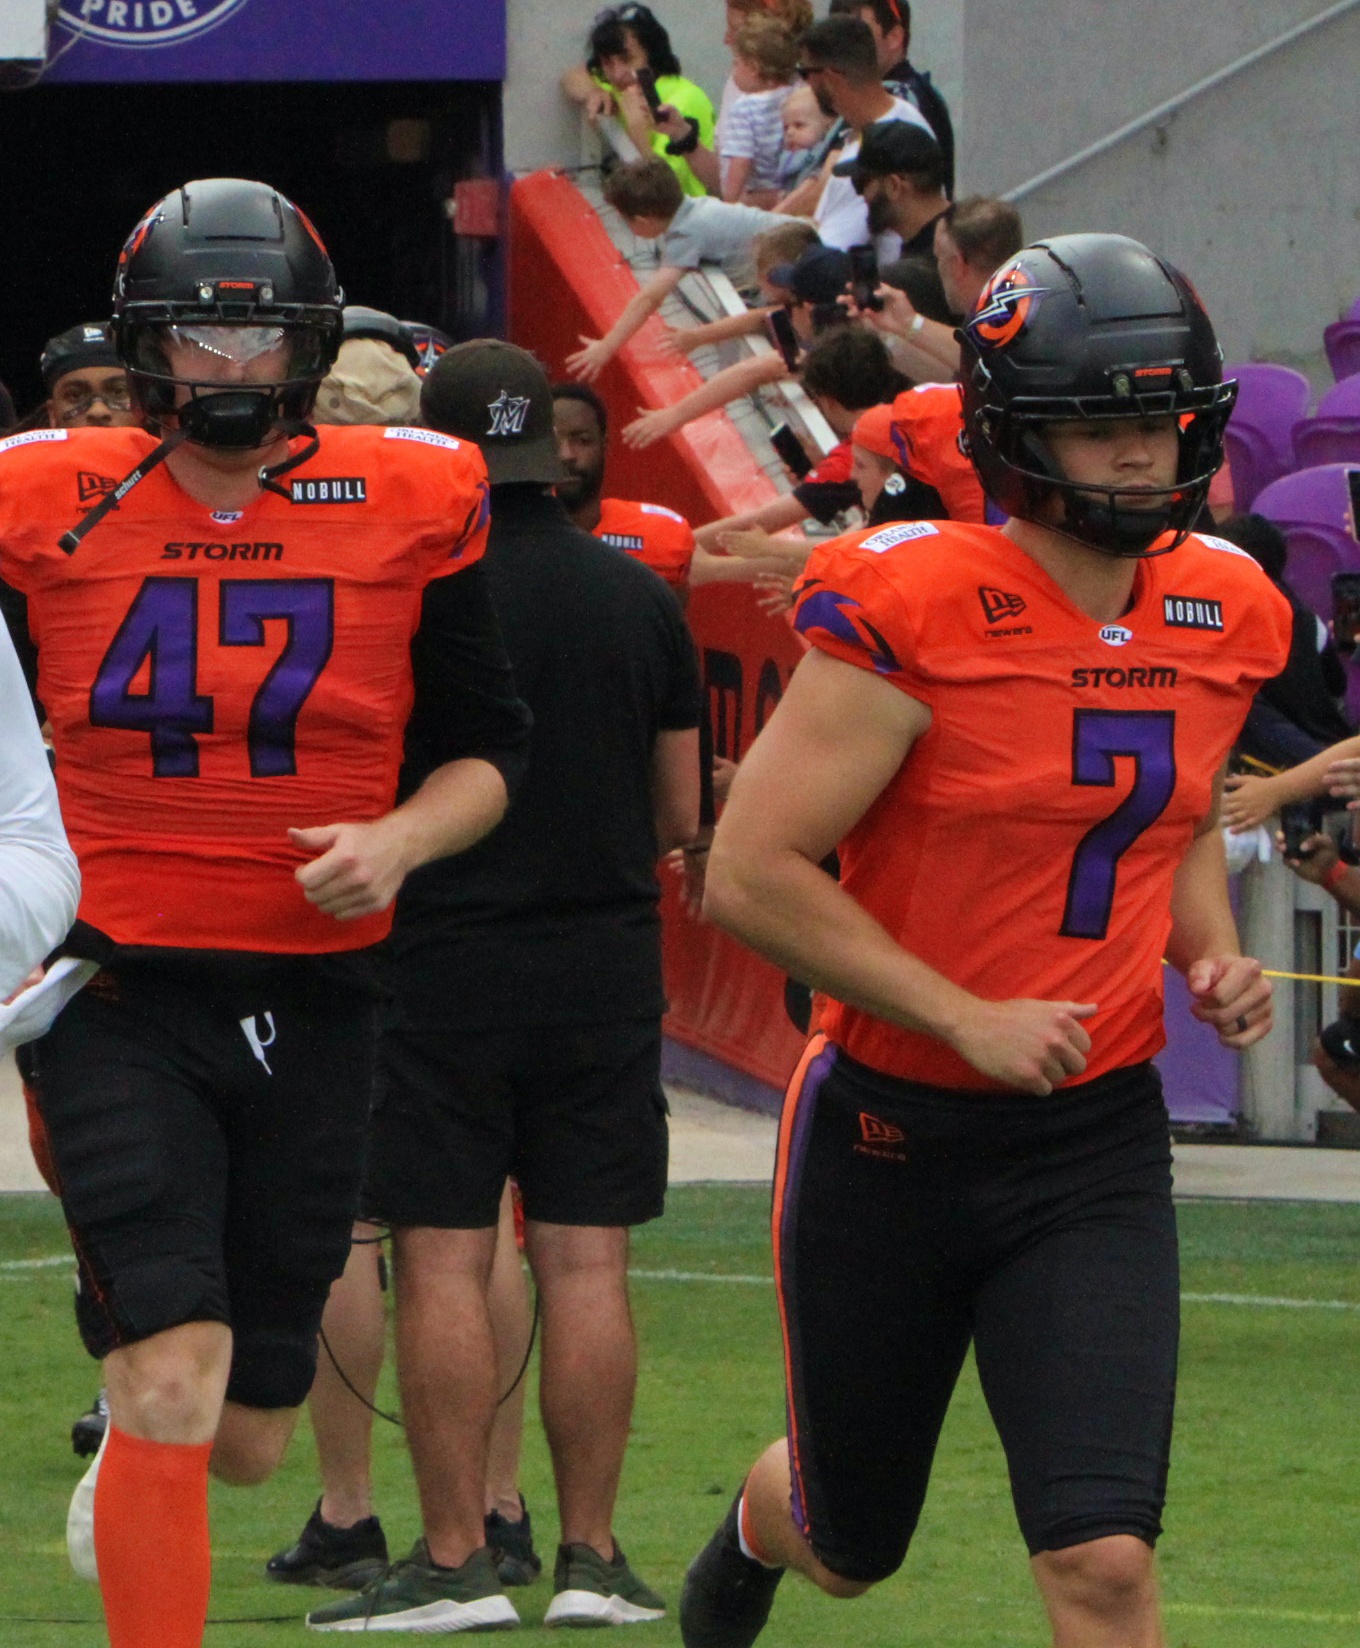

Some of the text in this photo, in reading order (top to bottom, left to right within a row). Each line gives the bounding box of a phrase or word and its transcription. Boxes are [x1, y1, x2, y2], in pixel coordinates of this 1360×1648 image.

[80, 0, 197, 28] PRIDE
[114, 469, 143, 501] schutt
[291, 480, 366, 500] NOBULL
[160, 542, 285, 561] STORM
[1164, 599, 1223, 628] NOBULL
[1101, 628, 1130, 643] UFL
[89, 575, 335, 779] 47
[1070, 667, 1179, 689] STORM
[1057, 706, 1177, 941] 7
